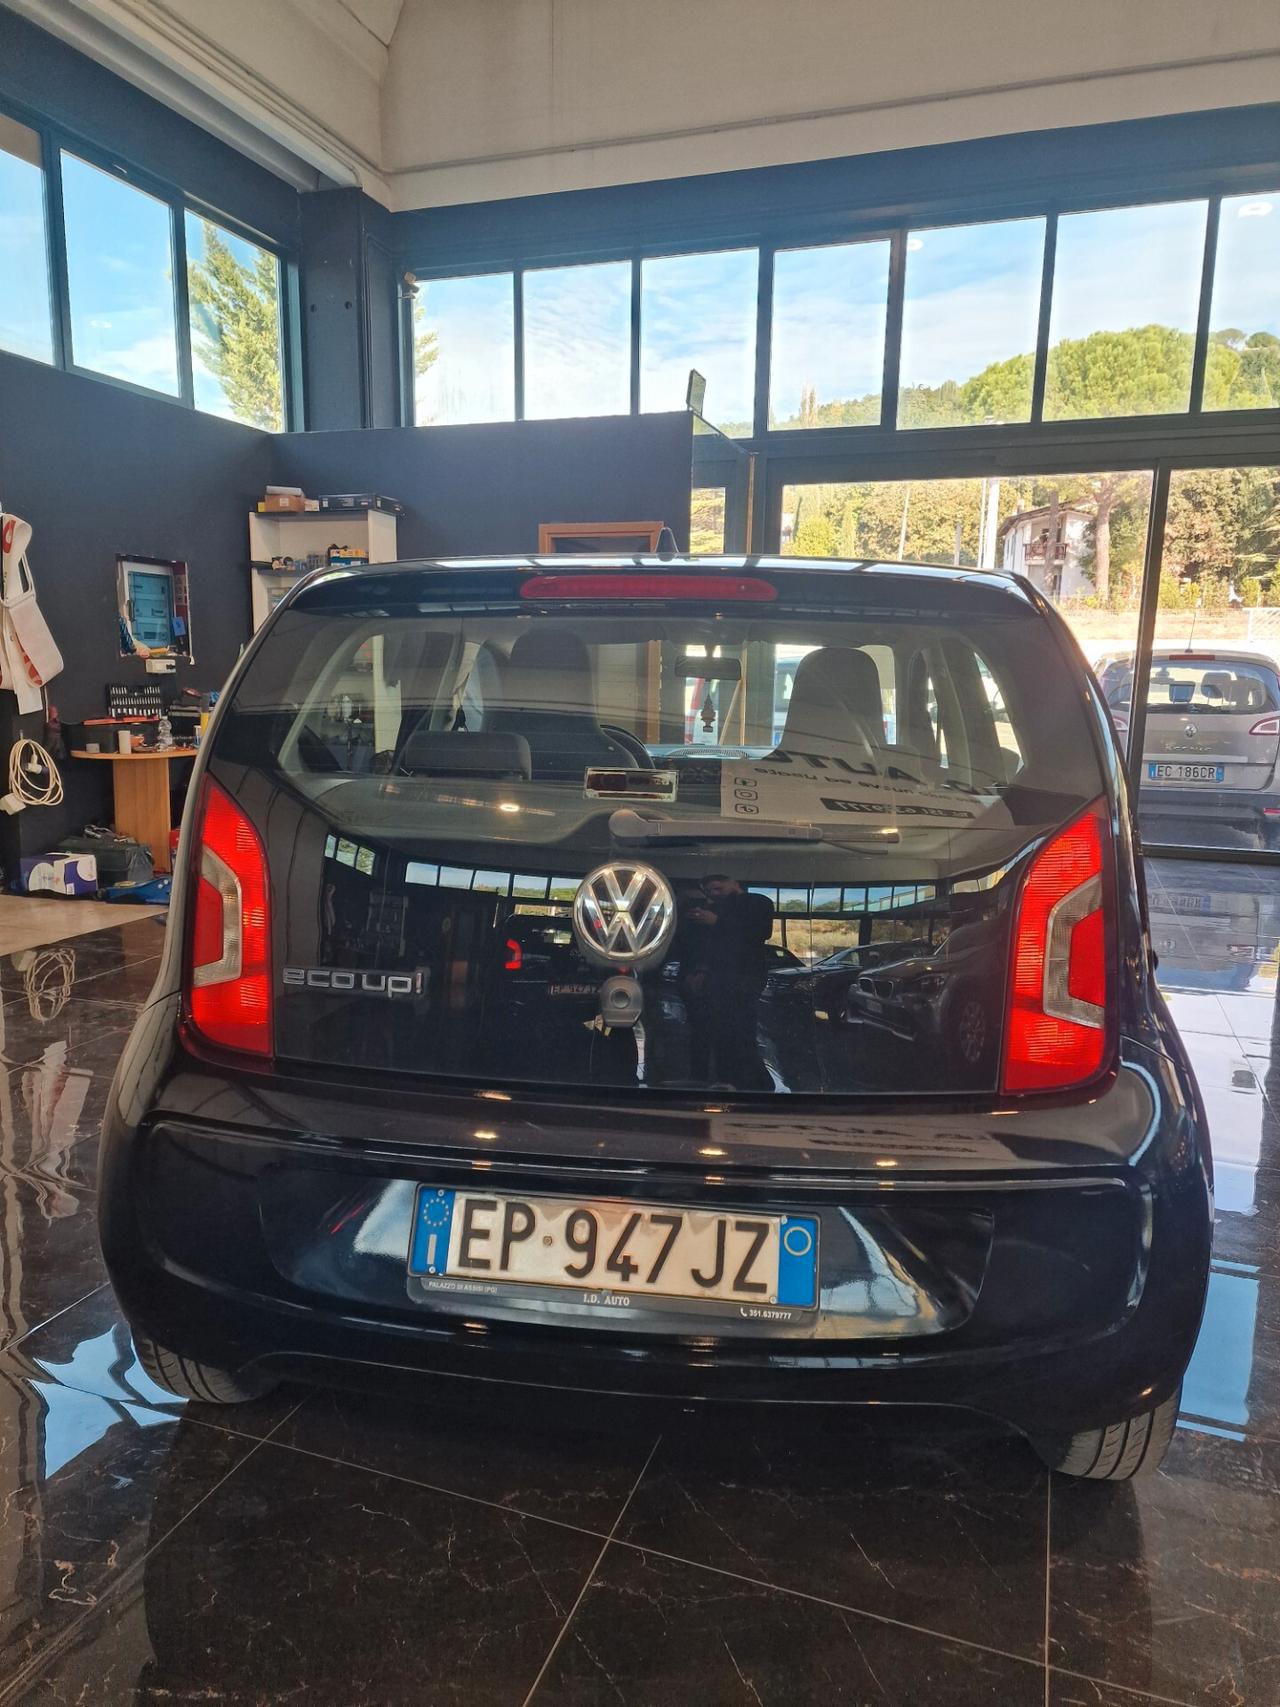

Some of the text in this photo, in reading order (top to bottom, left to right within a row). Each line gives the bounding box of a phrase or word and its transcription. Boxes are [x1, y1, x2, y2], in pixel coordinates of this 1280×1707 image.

[1157, 766, 1172, 777] EC
[283, 967, 422, 998] eco up!
[458, 1199, 769, 1294] EP 947 JZ
[428, 1281, 456, 1290] PALAZZO
[463, 1284, 483, 1292] ASSISI
[583, 1294, 630, 1306] I.D. AUTO
[749, 1309, 792, 1320] 351.6379777
